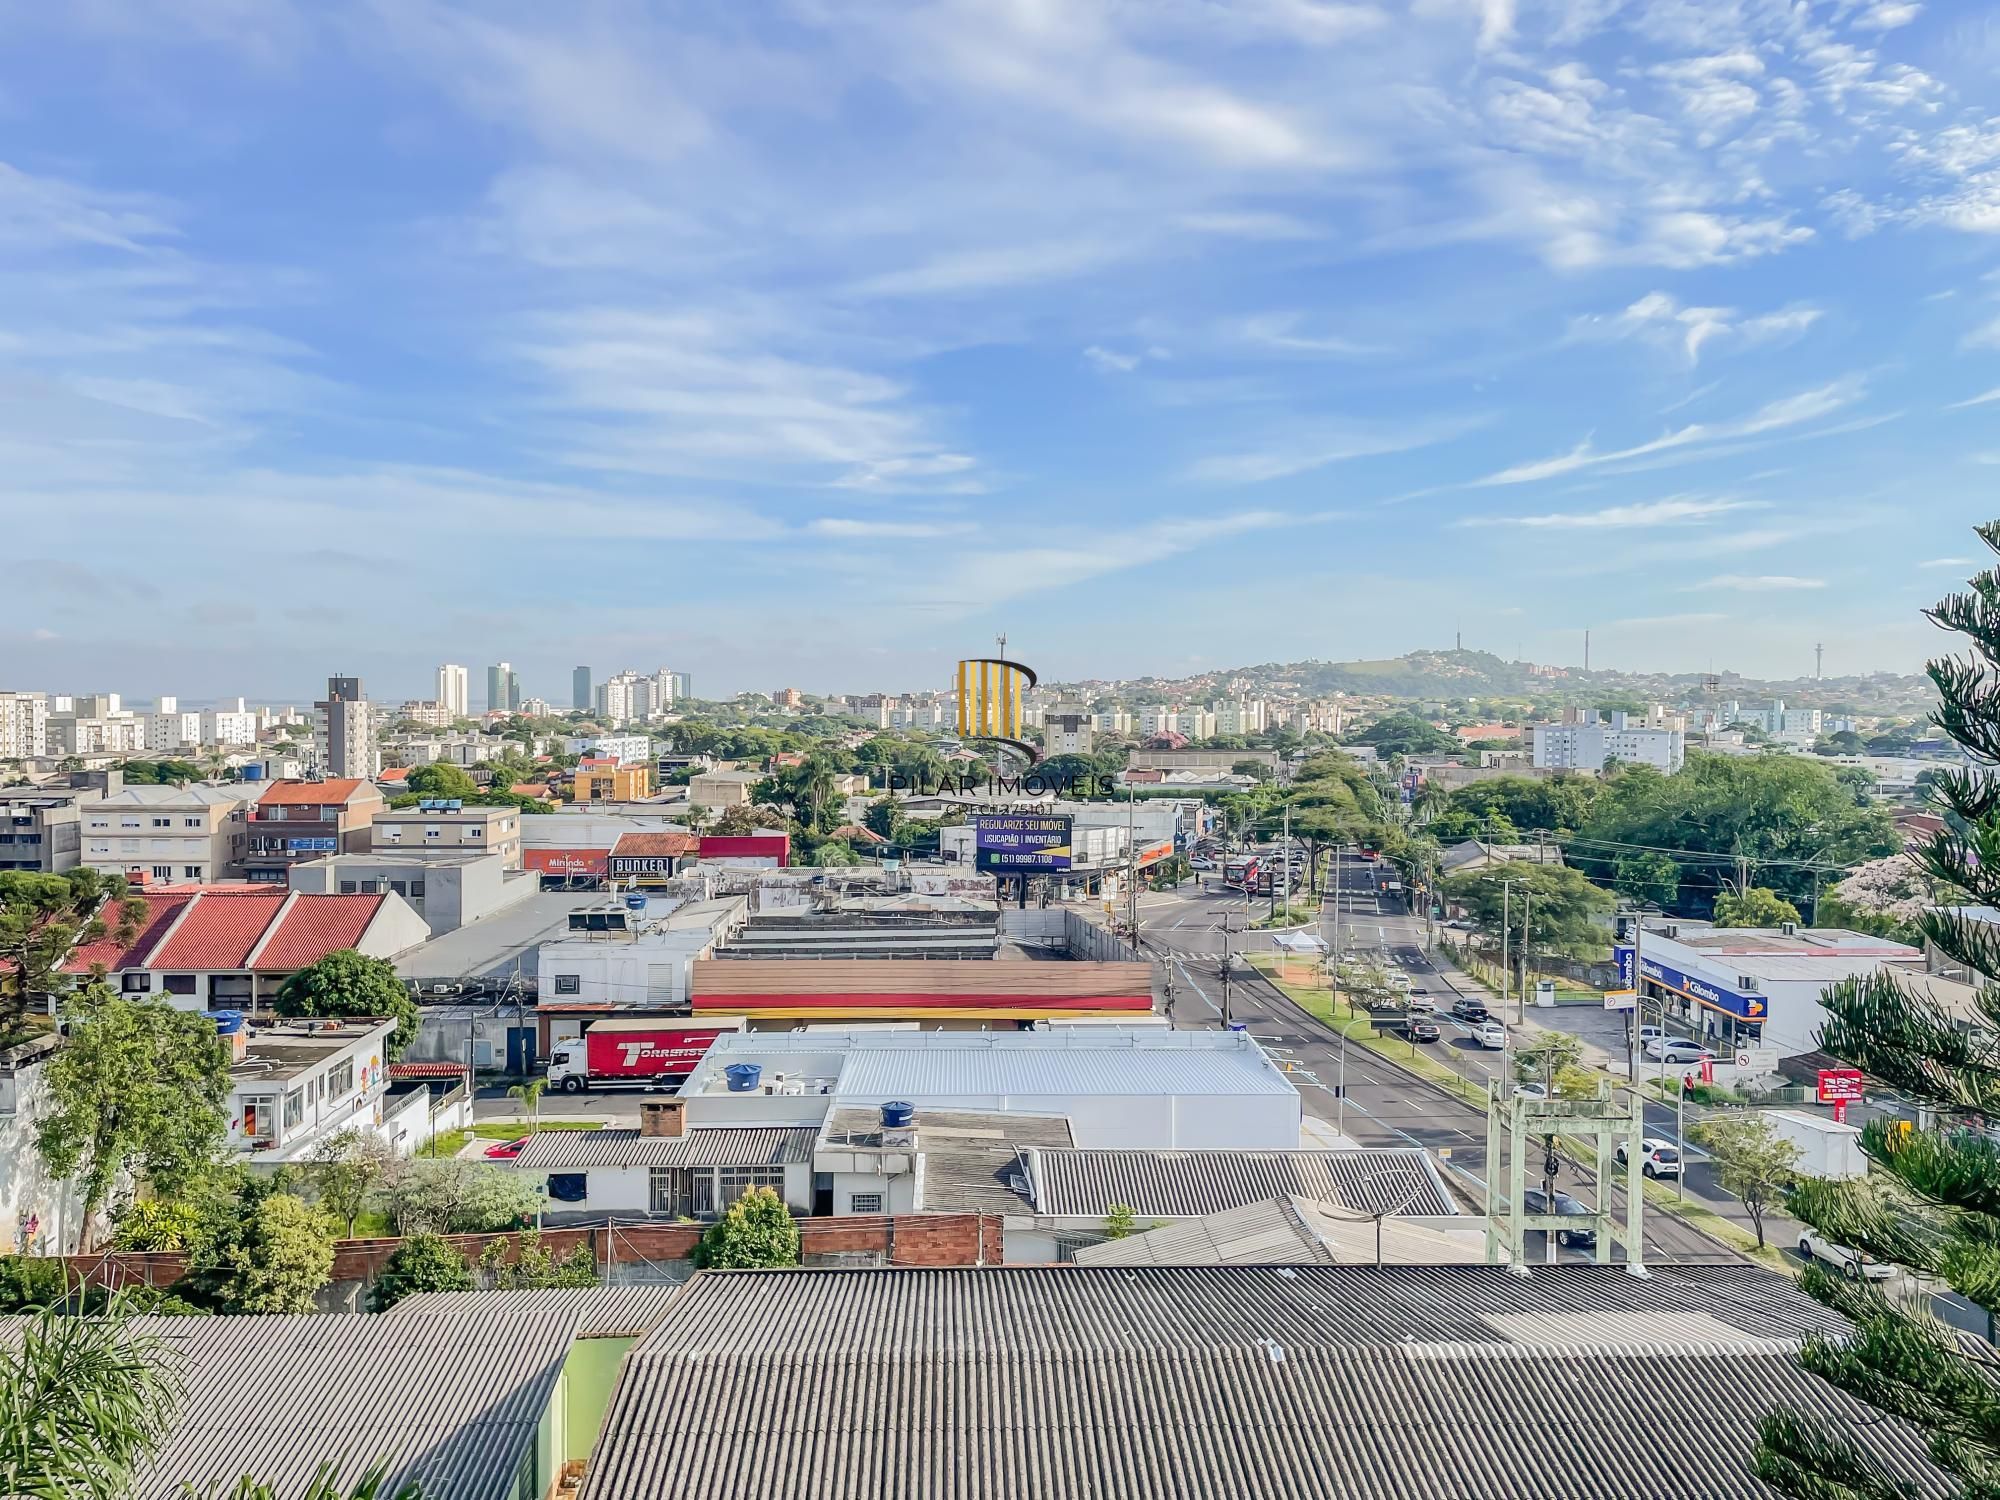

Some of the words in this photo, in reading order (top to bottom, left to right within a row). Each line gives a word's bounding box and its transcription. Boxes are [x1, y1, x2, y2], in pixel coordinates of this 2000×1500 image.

[980, 819, 1023, 830] REGULARIZE
[1025, 820, 1039, 831] SEU
[1040, 819, 1066, 831] IMÓVEL
[984, 834, 1019, 843] USUCAPIÃO
[1025, 834, 1062, 844] INVENTÁRIO
[1001, 854, 1015, 863] (51)
[616, 859, 664, 872] BUNKER
[1624, 952, 1633, 991] olombo
[1641, 961, 1662, 979] olombo
